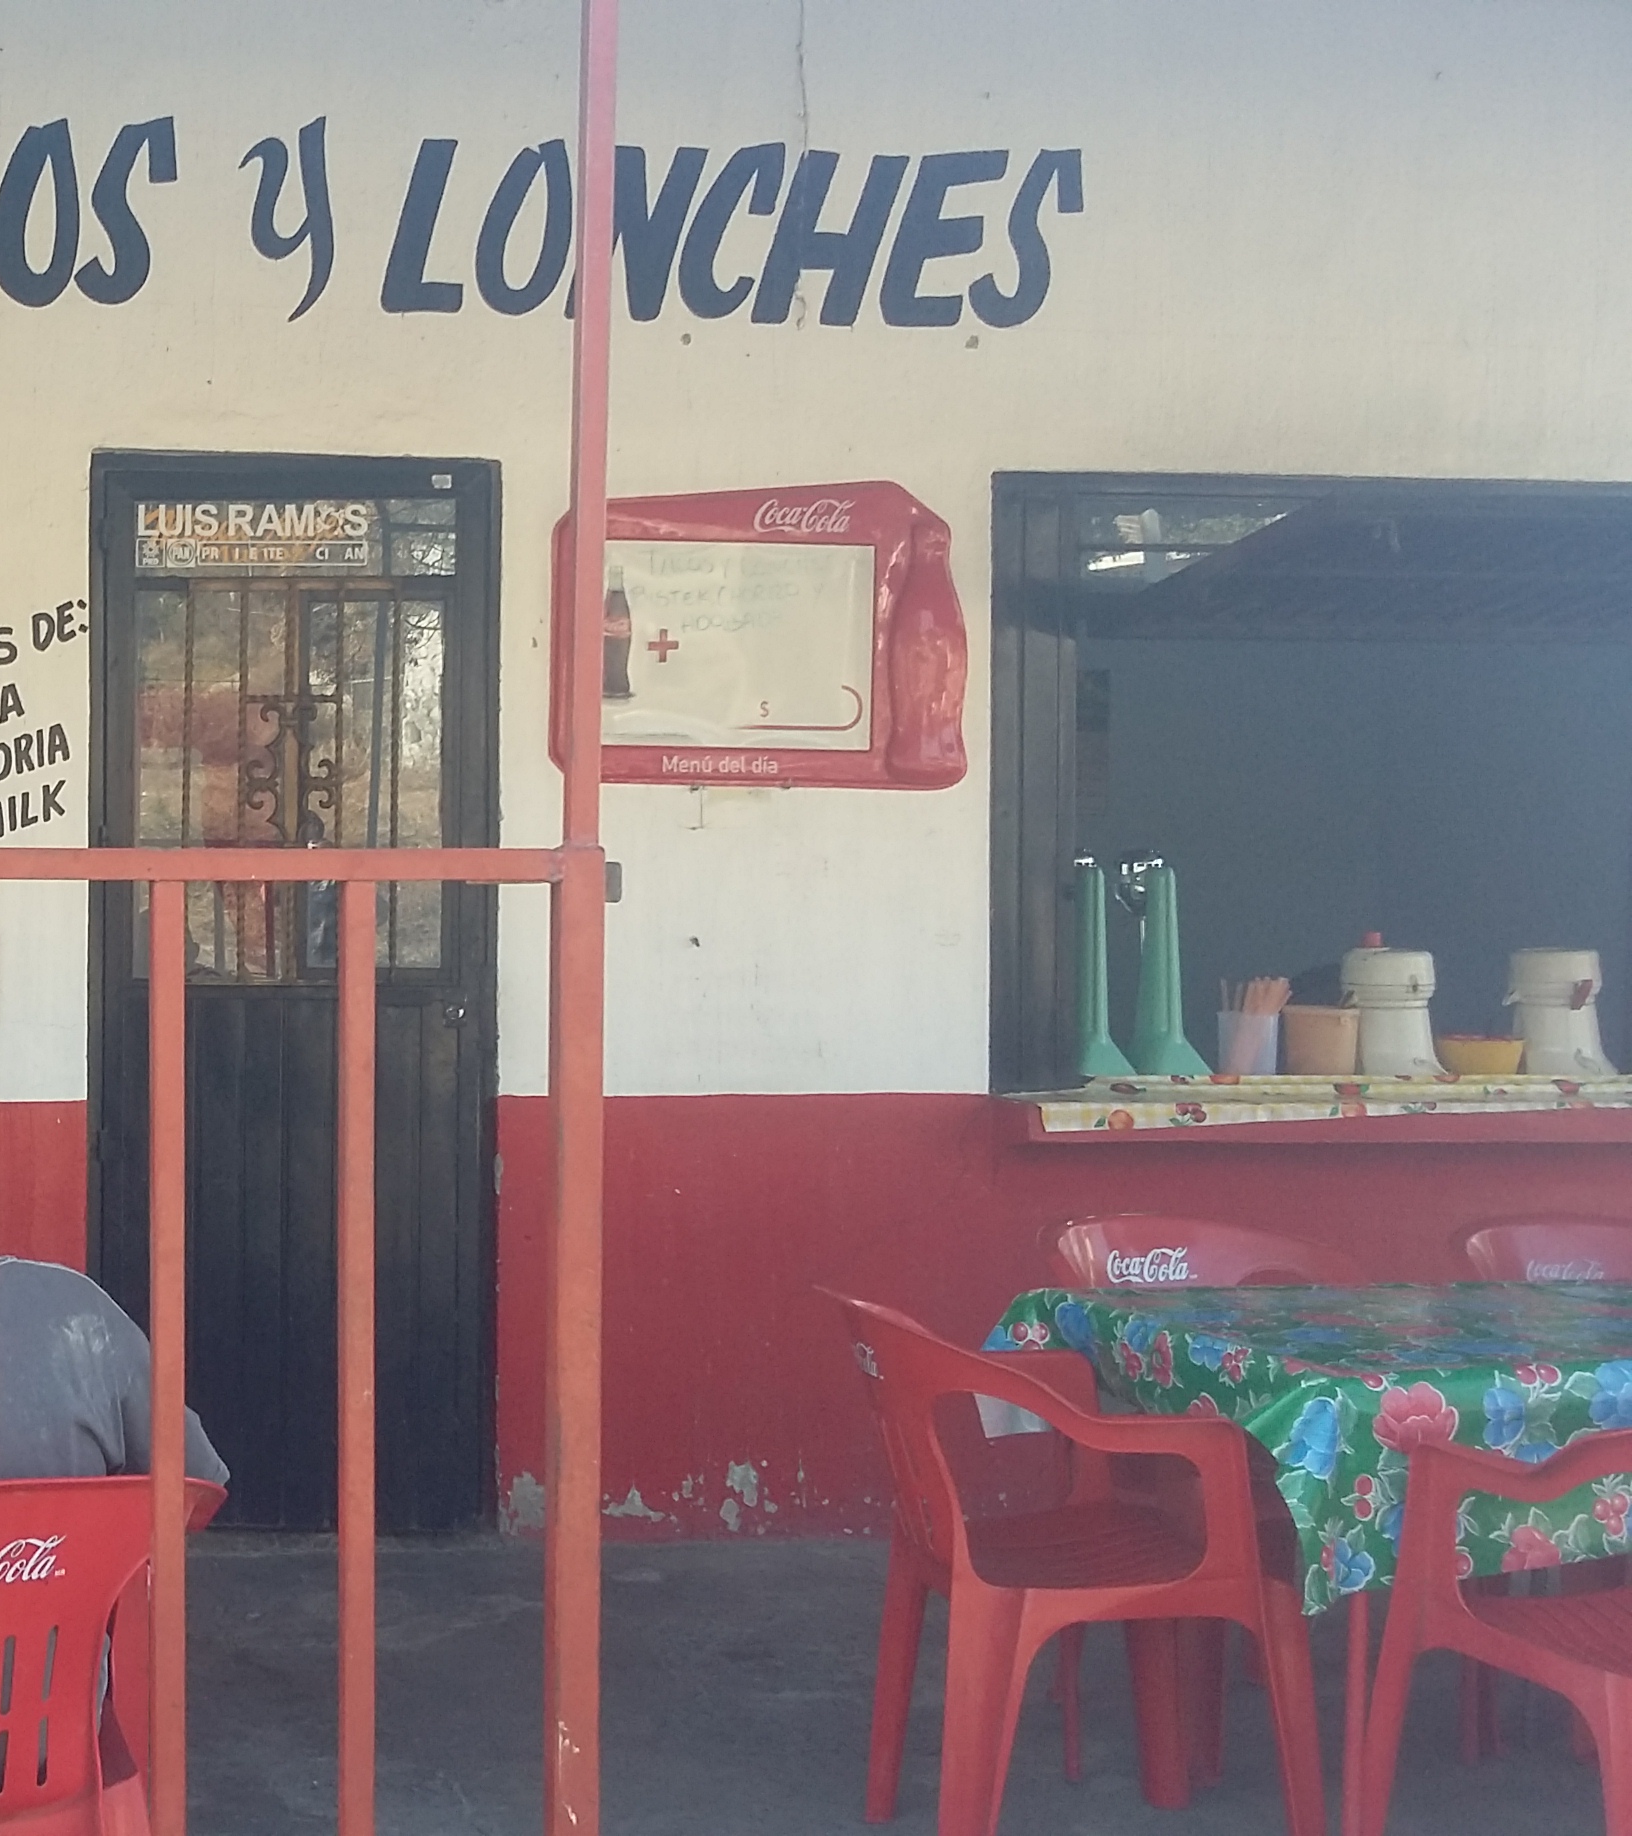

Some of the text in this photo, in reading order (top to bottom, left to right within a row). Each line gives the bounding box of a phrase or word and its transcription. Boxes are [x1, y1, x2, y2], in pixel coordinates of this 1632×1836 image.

[380, 138, 1085, 329] LONCHES
[137, 504, 219, 537] LUIS
[753, 499, 856, 533] Coca-Cola
[32, 599, 89, 652] DE:
[662, 755, 778, 774] Menú del día
[1107, 1247, 1189, 1284] Coca-Cola
